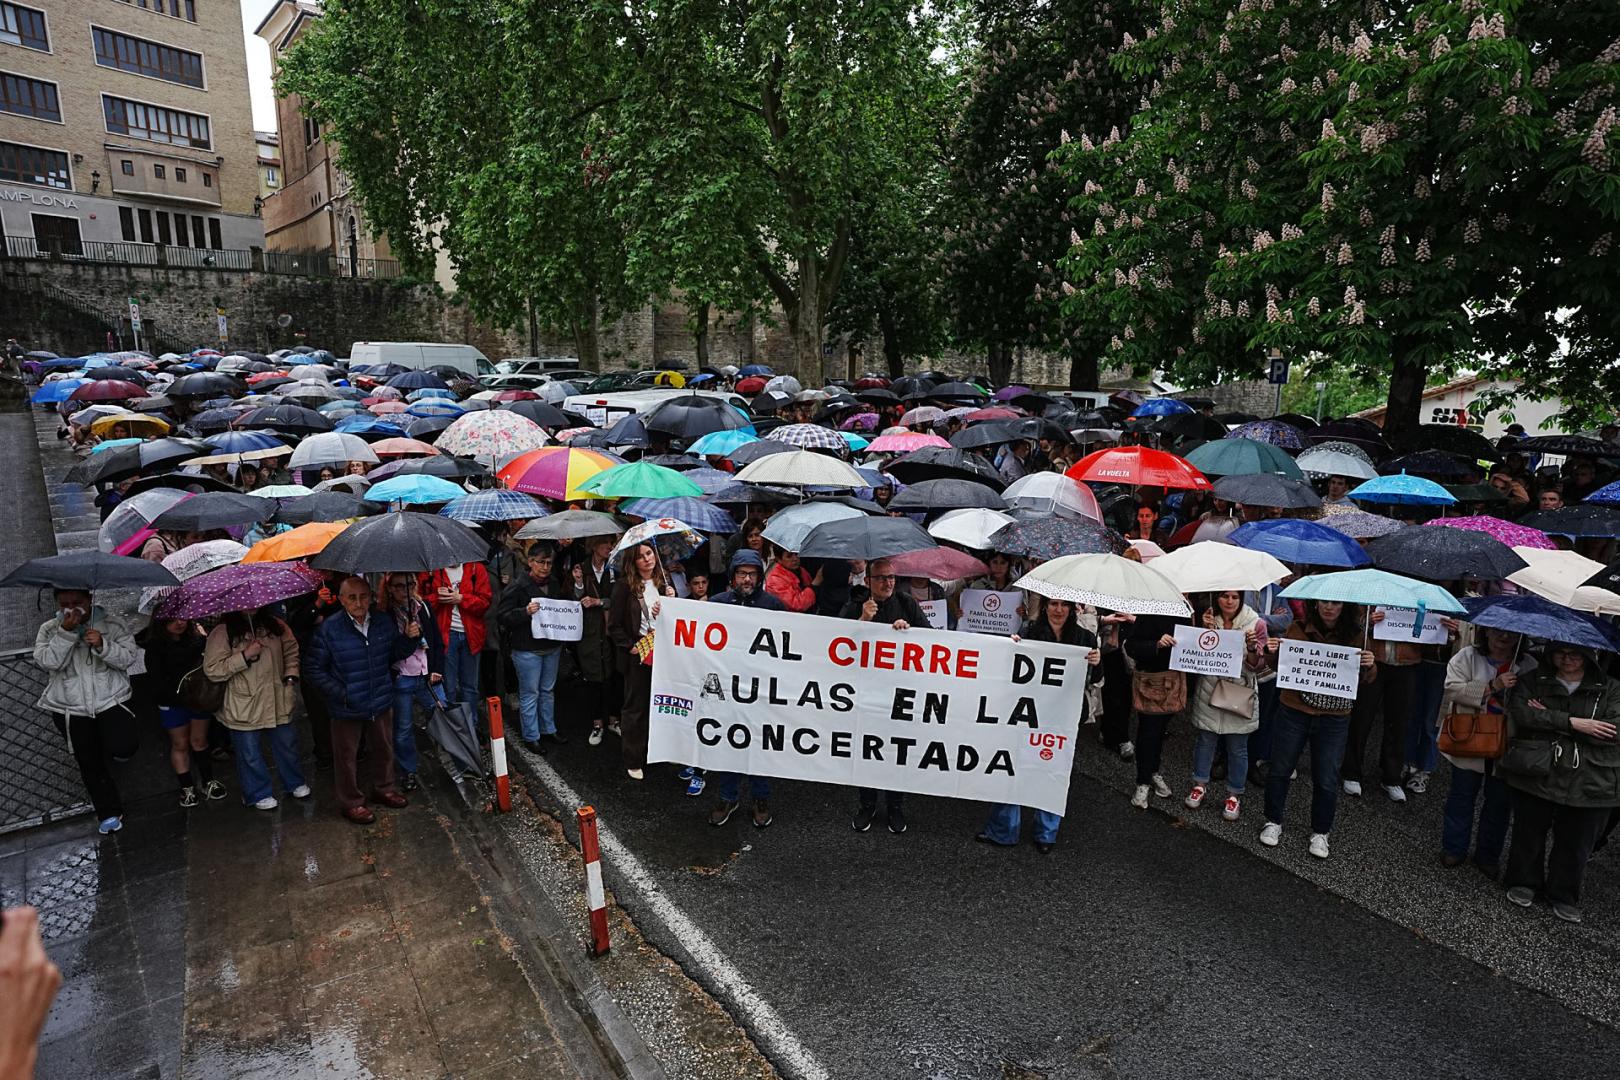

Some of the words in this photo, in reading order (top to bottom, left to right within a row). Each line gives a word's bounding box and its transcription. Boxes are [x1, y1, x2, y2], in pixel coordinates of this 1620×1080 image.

[1273, 361, 1285, 382] P
[969, 610, 998, 618] FAMILIAS
[1387, 621, 1438, 631] DISCRIMADA
[674, 619, 728, 651] NO
[749, 628, 802, 661] AL
[828, 636, 979, 679] CIERRE
[1011, 653, 1067, 687] DE
[1182, 649, 1215, 658] FAMILIAS
[1289, 646, 1304, 654] POR
[1326, 651, 1350, 661] LIBRE
[1299, 658, 1337, 669] ELECCIÓN
[1306, 669, 1337, 679] CENTRO
[1295, 677, 1310, 685] LAS
[1315, 680, 1352, 692] FAMILIAS.
[654, 695, 692, 710] SEPNA
[700, 673, 856, 712] AULAS
[890, 687, 949, 724] EN
[976, 696, 1039, 728] LA
[696, 717, 1015, 776] CONCERTADA
[1029, 733, 1067, 750] UGT
